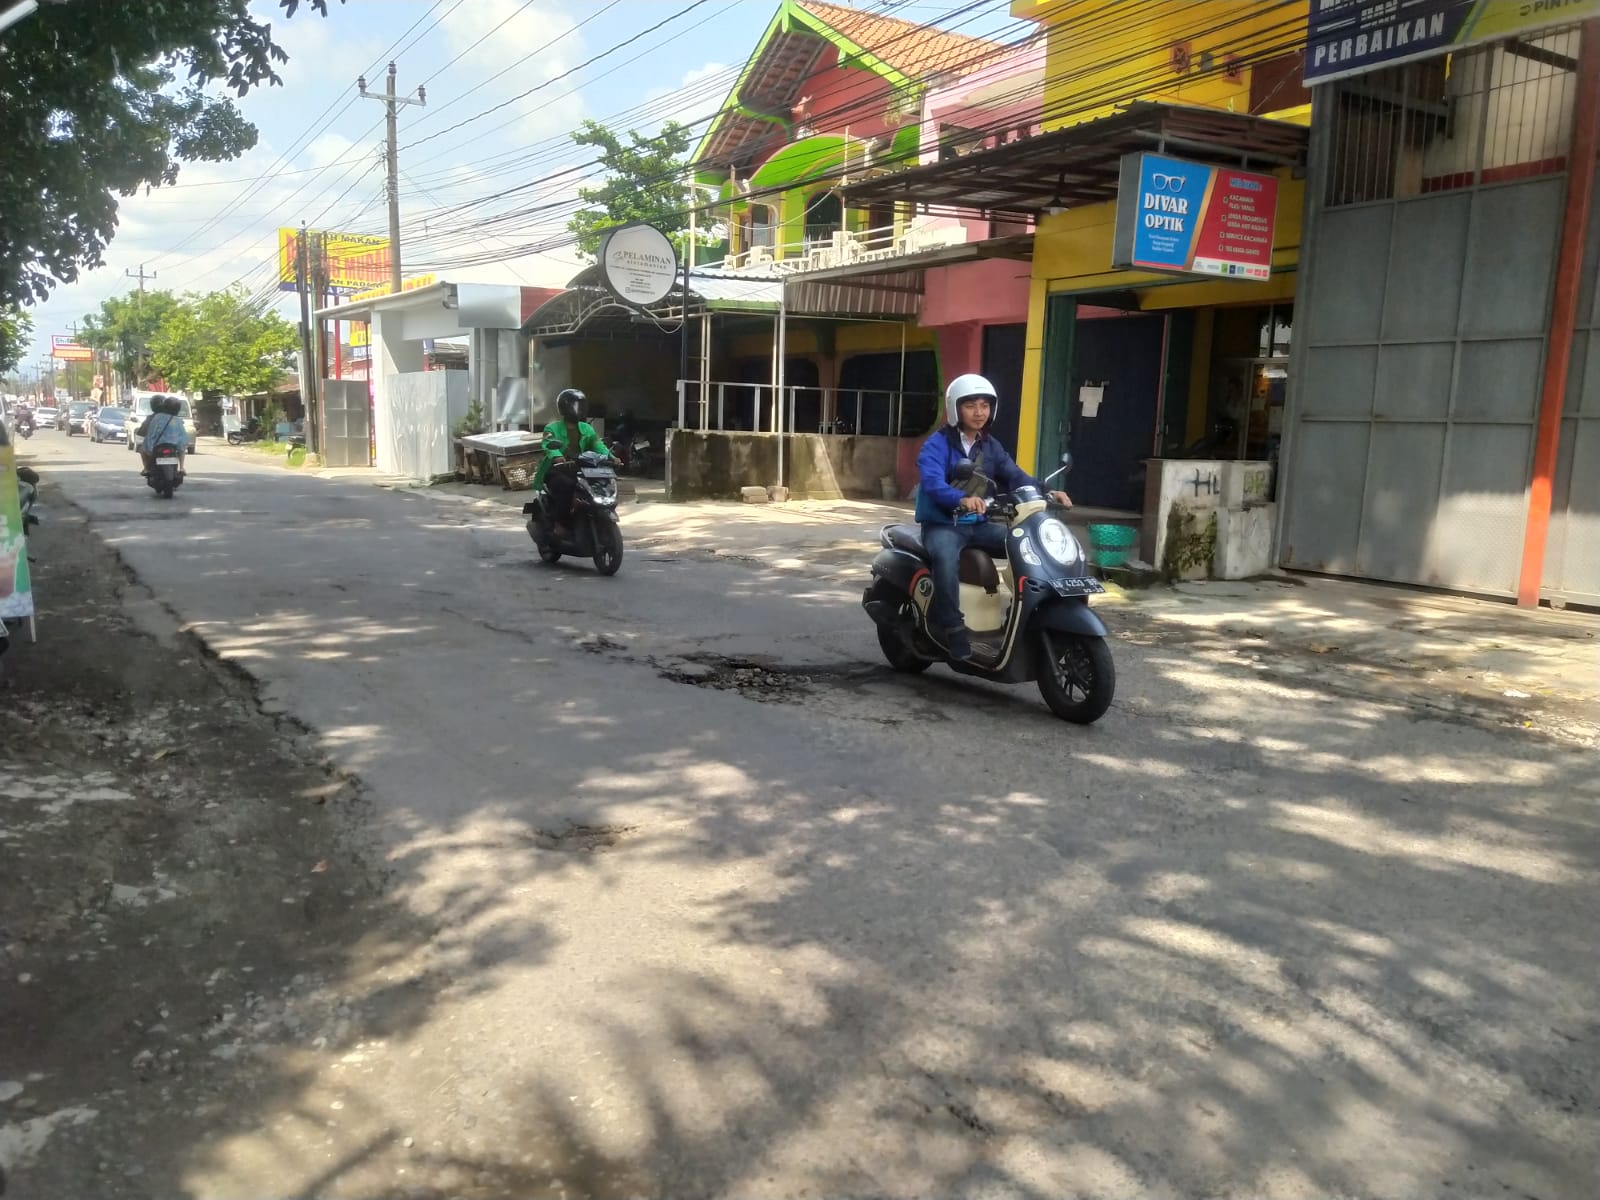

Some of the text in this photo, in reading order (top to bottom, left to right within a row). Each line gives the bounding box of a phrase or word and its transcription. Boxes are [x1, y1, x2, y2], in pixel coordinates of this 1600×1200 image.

[1314, 12, 1445, 67] PERBAIKAN
[1144, 192, 1188, 215] DIVAR
[1145, 213, 1185, 232] OPTIK
[623, 251, 672, 265] PELAMINAN
